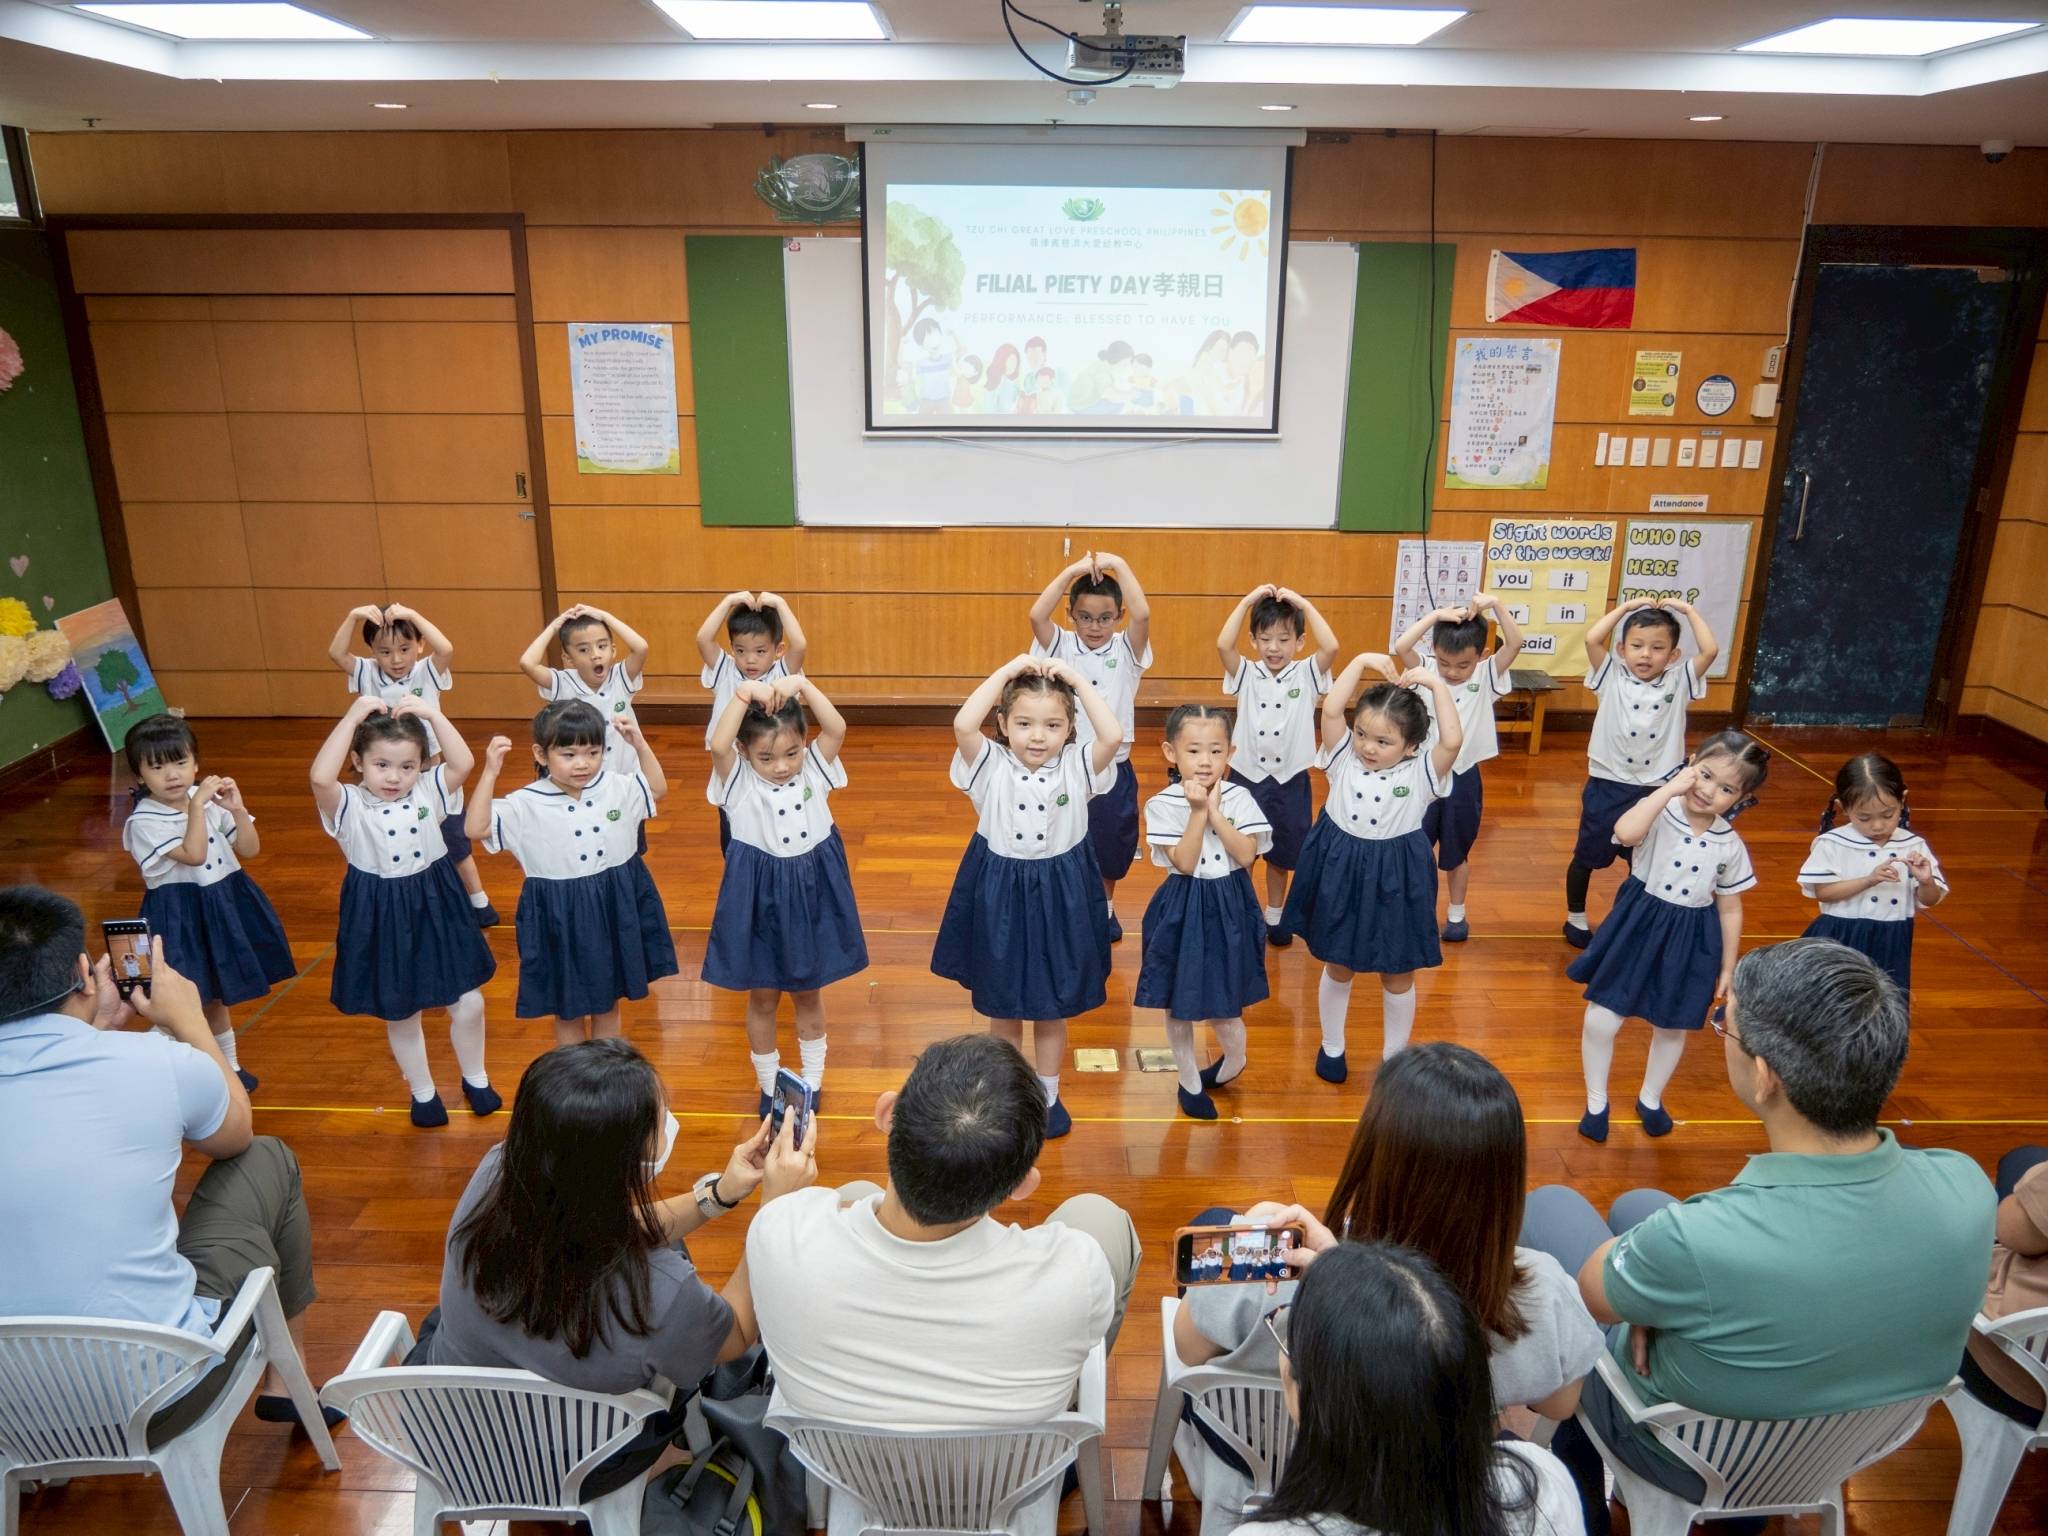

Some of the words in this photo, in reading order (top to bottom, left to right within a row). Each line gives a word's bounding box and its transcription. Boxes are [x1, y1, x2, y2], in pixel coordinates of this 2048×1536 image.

[1011, 224, 1045, 234] GREAT
[1049, 225, 1076, 235] LOVE
[1080, 225, 1142, 236] PRESCHOOL
[1146, 226, 1208, 237] PHILIPPINES
[976, 274, 1038, 294] FILIAL
[1045, 274, 1103, 295] PIETY
[1074, 313, 1132, 326] BLESSED
[1138, 314, 1155, 326] TO
[1161, 315, 1196, 326] HAVE
[1203, 315, 1231, 327] YOU
[578, 332, 599, 349] MY
[601, 328, 665, 350] PROMISE
[1653, 500, 1704, 508] Attendance
[1493, 523, 1547, 542] Sight
[1551, 524, 1613, 540] words
[1630, 528, 1676, 545] WHO
[1680, 530, 1701, 547] IS
[1488, 543, 1512, 560] of
[1515, 545, 1550, 561] the
[1552, 546, 1612, 562] week!
[1627, 558, 1679, 577] HERE
[1498, 574, 1527, 587] you
[1563, 572, 1574, 587] it
[1686, 587, 1700, 605] ?
[1561, 607, 1575, 619] in
[1521, 637, 1552, 649] said
